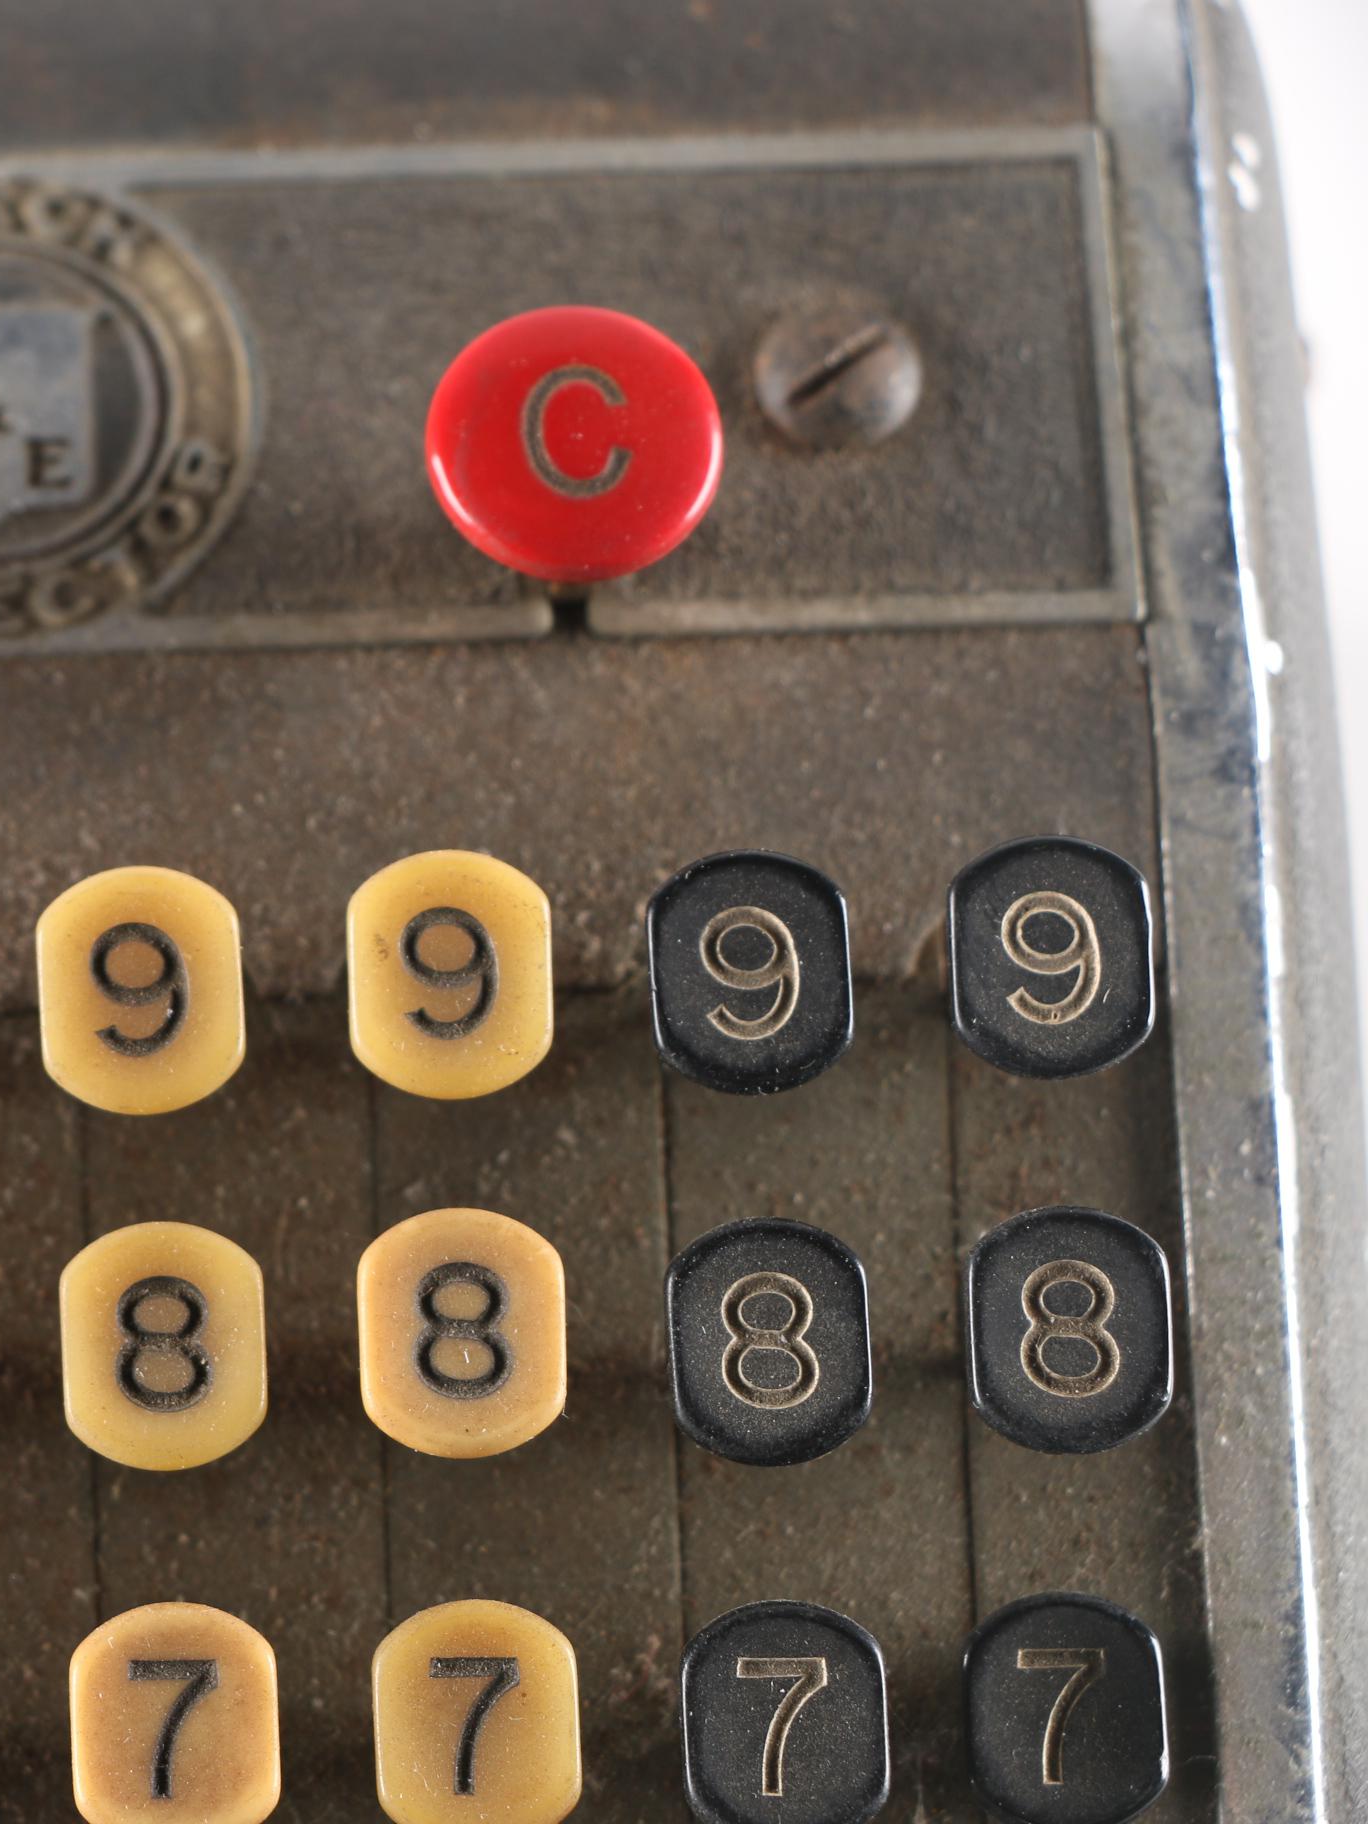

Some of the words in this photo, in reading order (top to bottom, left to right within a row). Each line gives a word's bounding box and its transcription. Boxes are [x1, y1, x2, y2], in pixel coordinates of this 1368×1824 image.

[26, 436, 71, 488] E
[521, 364, 632, 498] C
[90, 922, 188, 1057] 9
[400, 906, 497, 1040] 9
[700, 906, 800, 1040] 9
[1002, 891, 1101, 1024] 9
[116, 1276, 213, 1412] 8
[416, 1262, 512, 1399] 8
[721, 1272, 819, 1409] 8
[1021, 1260, 1119, 1398] 8
[130, 1659, 217, 1799] 7
[430, 1657, 520, 1796] 7
[737, 1657, 827, 1796] 7
[1017, 1648, 1105, 1786] 7
